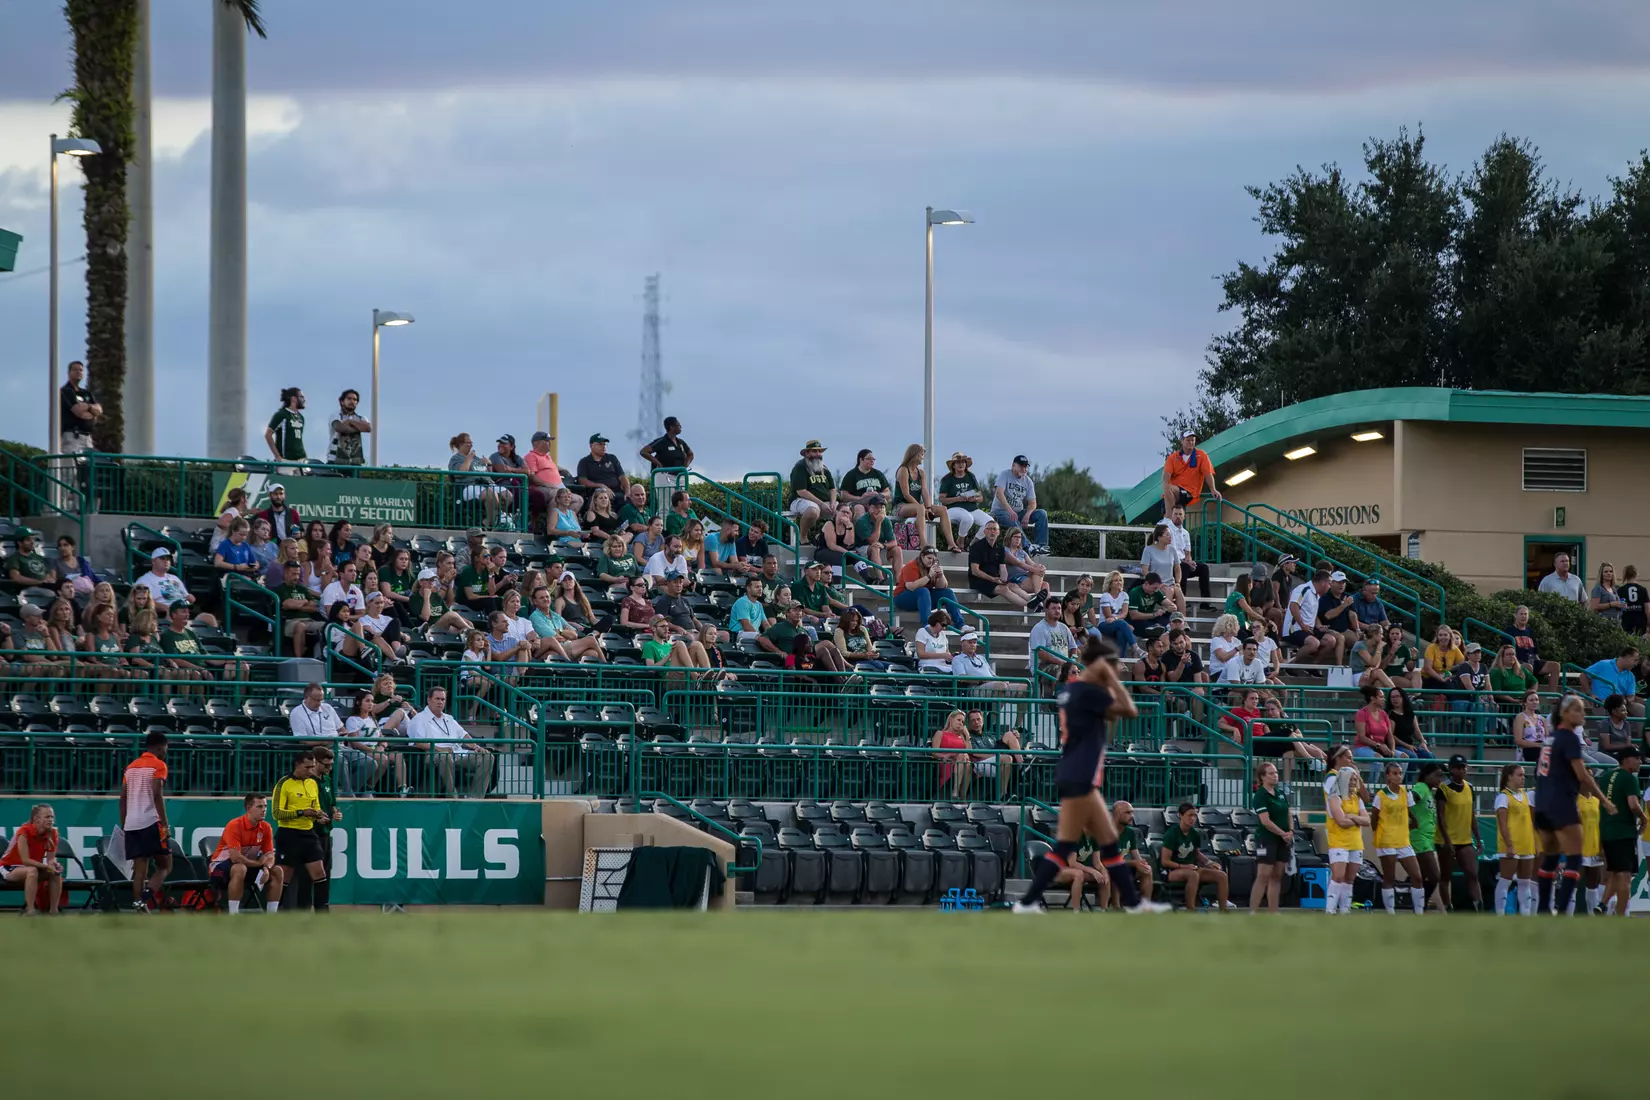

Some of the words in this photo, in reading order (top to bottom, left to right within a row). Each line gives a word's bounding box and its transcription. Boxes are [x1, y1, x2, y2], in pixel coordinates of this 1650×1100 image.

[336, 495, 361, 505] JOHN
[363, 496, 371, 506] &
[373, 497, 415, 508] MARILYN
[360, 506, 415, 522] SECTION
[1276, 503, 1380, 529] CONCESSIONS
[1627, 585, 1639, 603] 6
